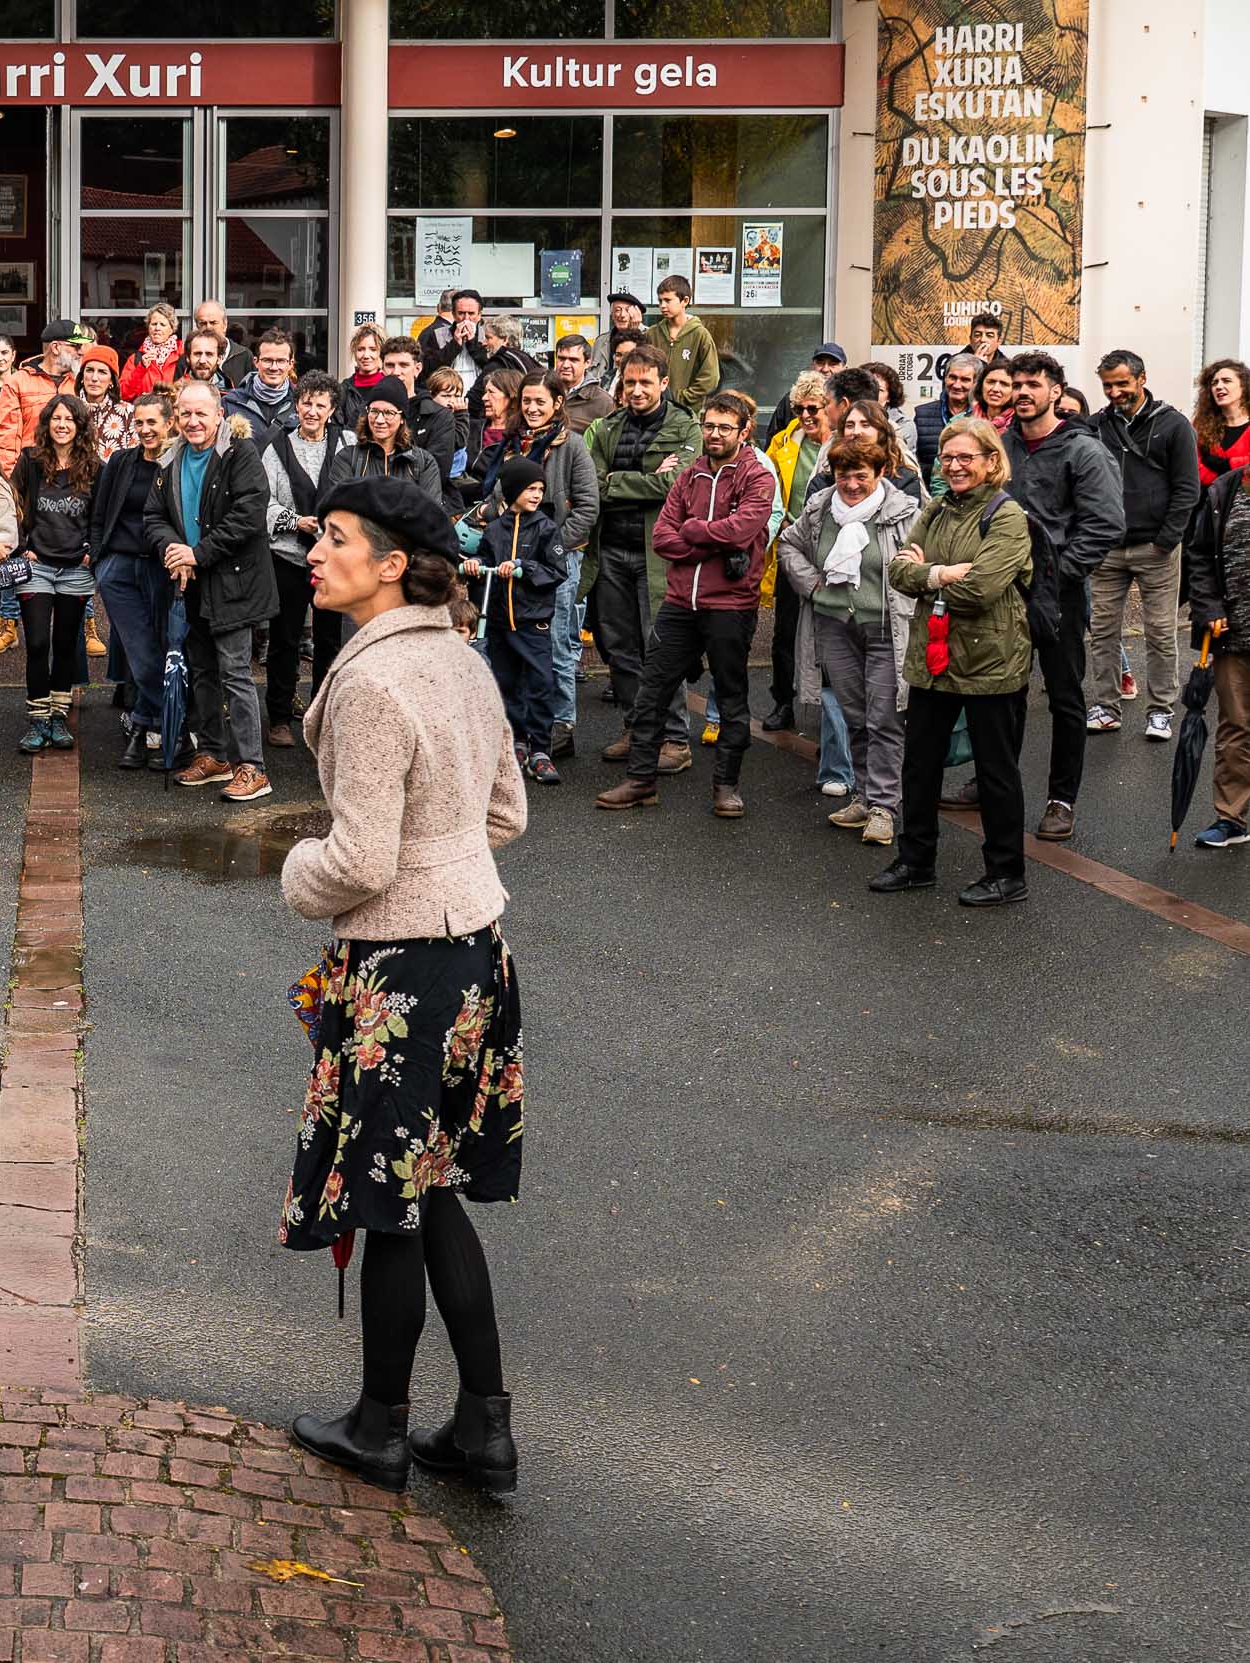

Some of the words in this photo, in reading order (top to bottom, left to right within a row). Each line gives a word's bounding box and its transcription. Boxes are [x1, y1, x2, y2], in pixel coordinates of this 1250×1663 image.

[935, 22, 1023, 53] HARRI
[84, 51, 203, 98] Xuri
[503, 56, 622, 88] Kultur
[634, 56, 718, 95] gela
[933, 56, 1023, 87] XURIA
[914, 88, 1043, 121] ESKUTAN
[902, 137, 940, 166] DU
[948, 134, 1054, 165] KAOLIN
[910, 168, 986, 198] SOUS
[994, 167, 1043, 196] LES
[934, 200, 1017, 229] PIEDS
[356, 313, 374, 324] 356
[943, 300, 1002, 316] LUHUSO
[898, 353, 906, 380] URRIAK
